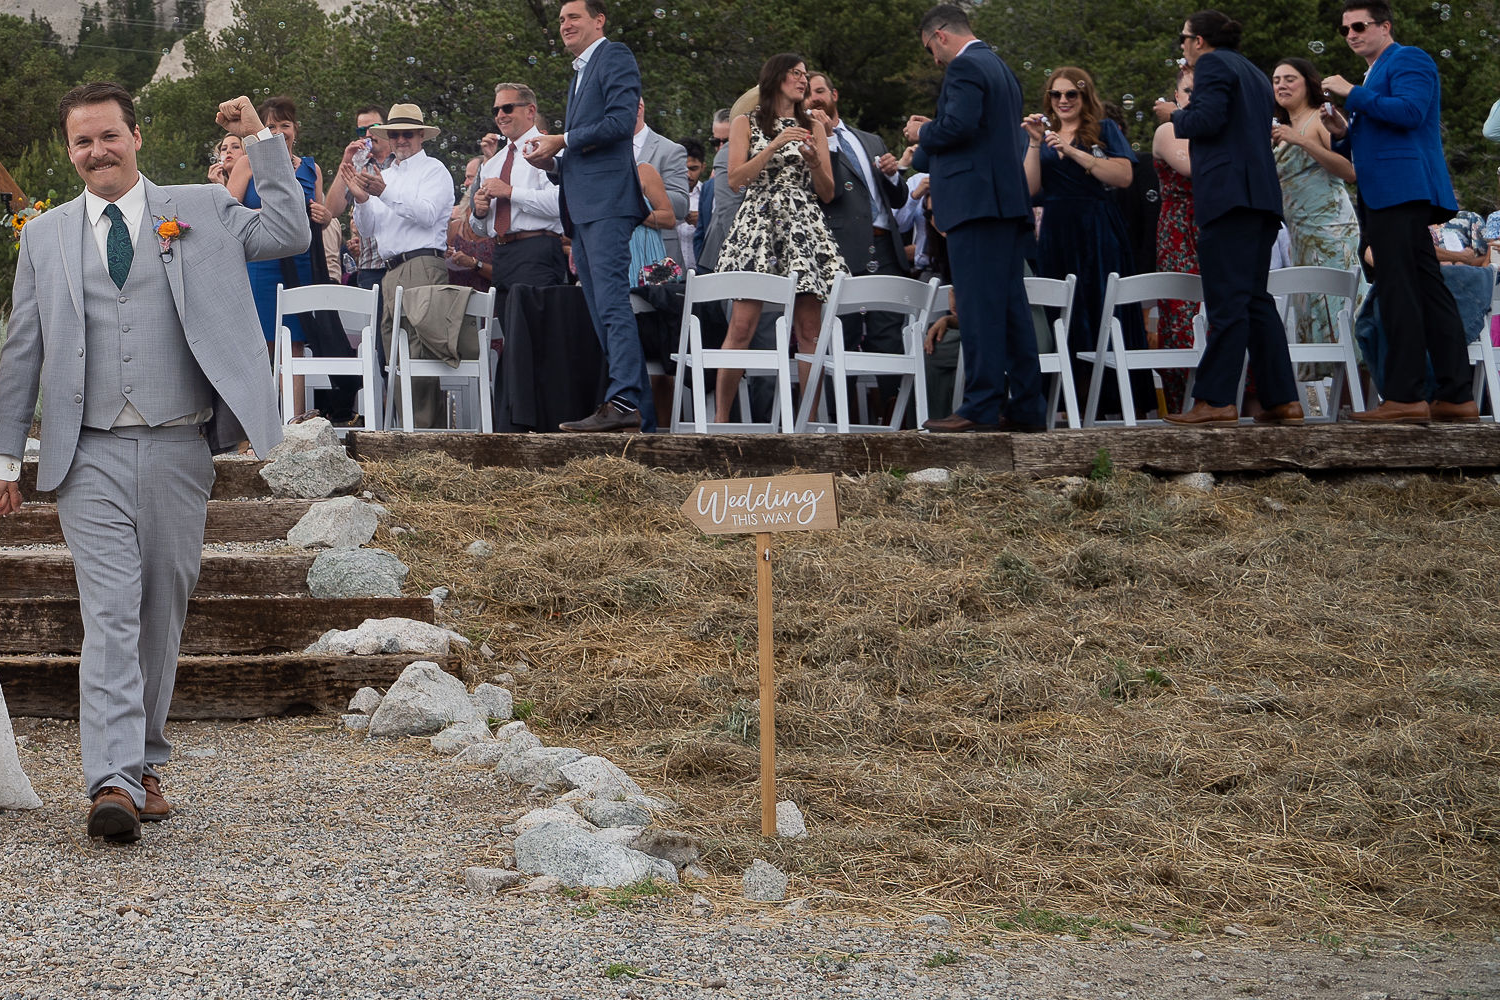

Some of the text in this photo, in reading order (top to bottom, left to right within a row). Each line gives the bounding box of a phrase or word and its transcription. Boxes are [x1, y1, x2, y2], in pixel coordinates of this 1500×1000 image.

[697, 482, 825, 524] Wedding
[732, 512, 792, 526] THIS WAY
